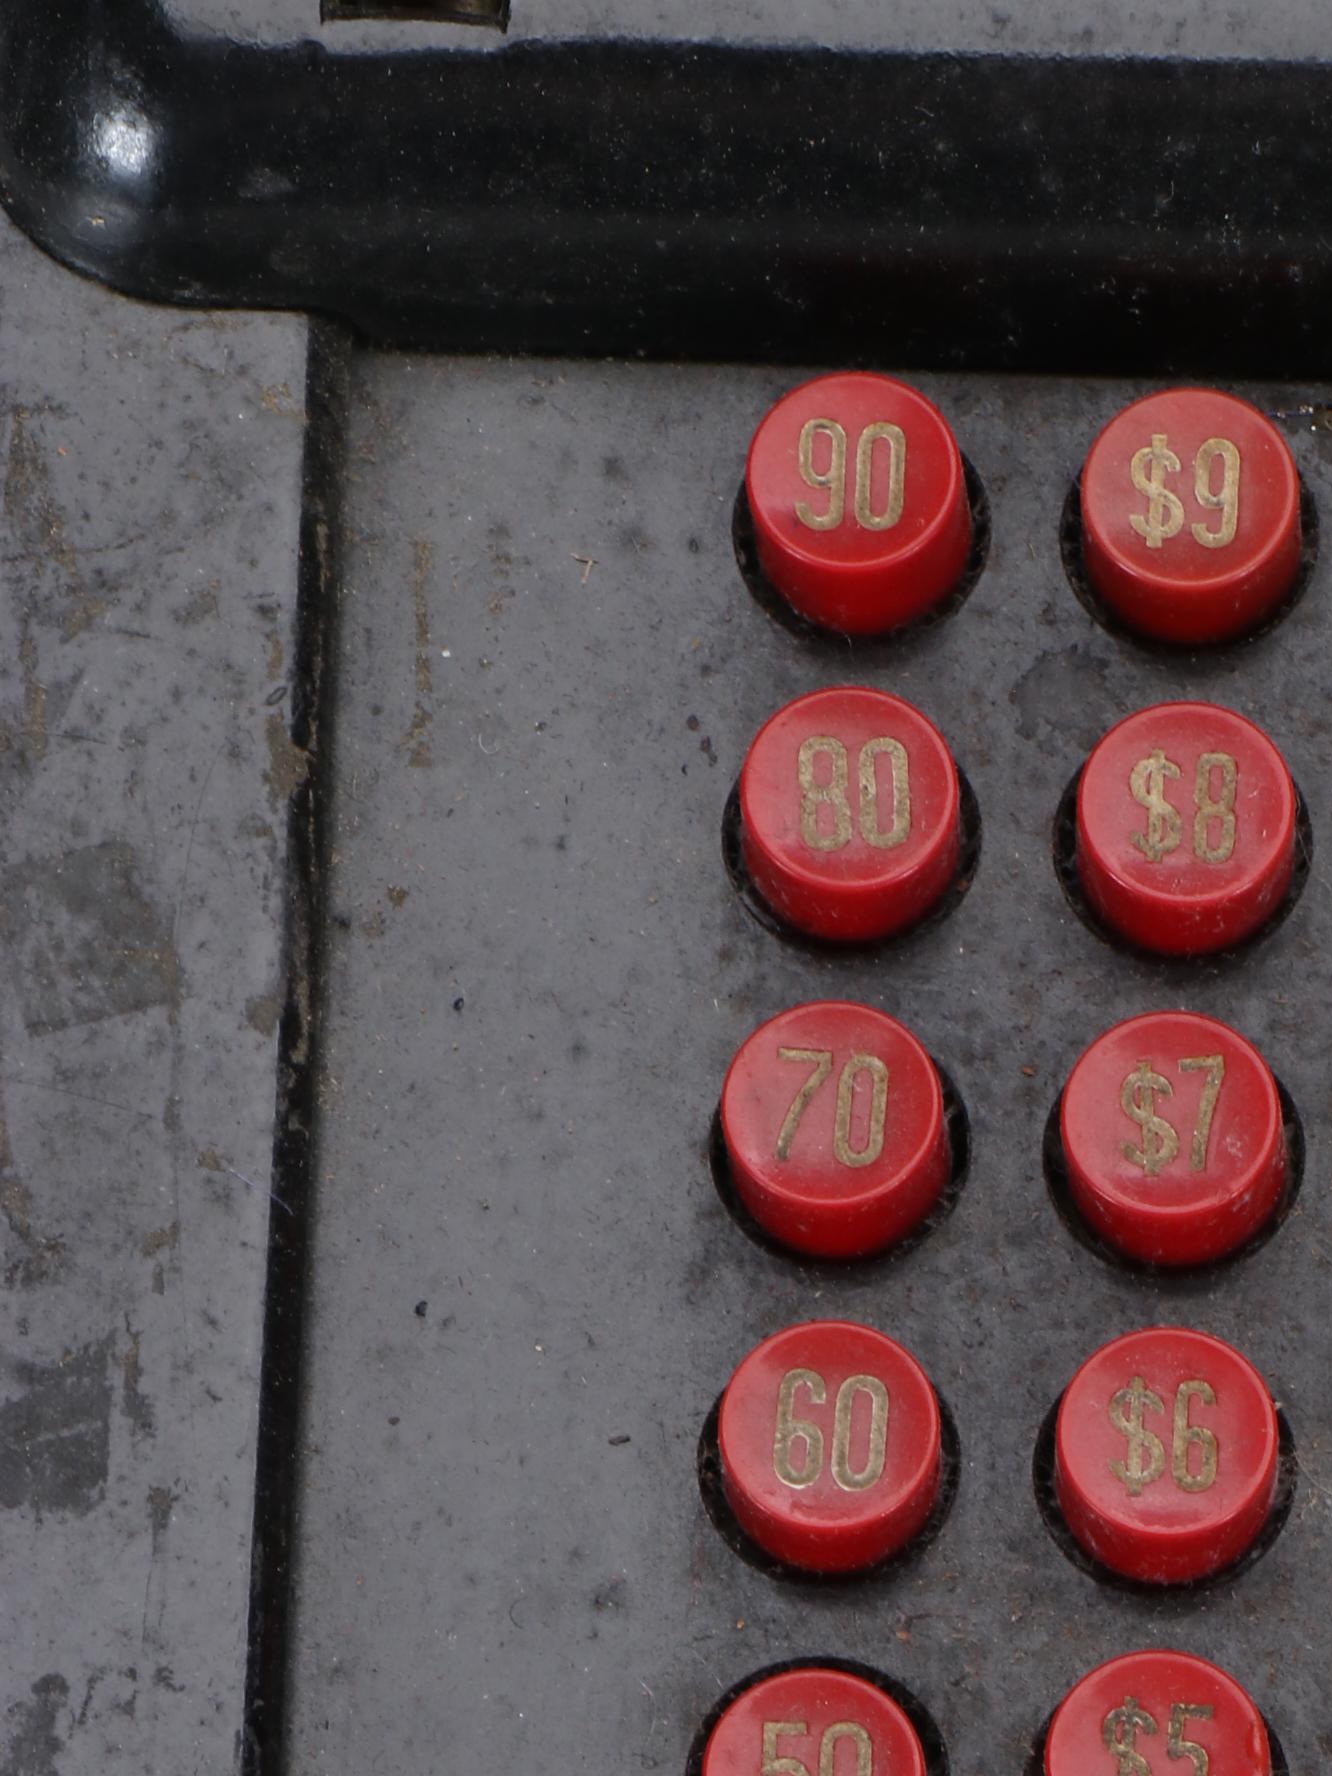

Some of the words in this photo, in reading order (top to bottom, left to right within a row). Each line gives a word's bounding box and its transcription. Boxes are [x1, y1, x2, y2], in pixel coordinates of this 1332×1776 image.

[796, 418, 906, 530] 90
[1129, 433, 1240, 548] $9
[798, 735, 910, 851] 80
[1129, 749, 1237, 863] $8
[776, 1046, 889, 1168] 70
[1119, 1054, 1224, 1175] $7
[773, 1368, 889, 1491] 60
[1108, 1376, 1219, 1496] $6
